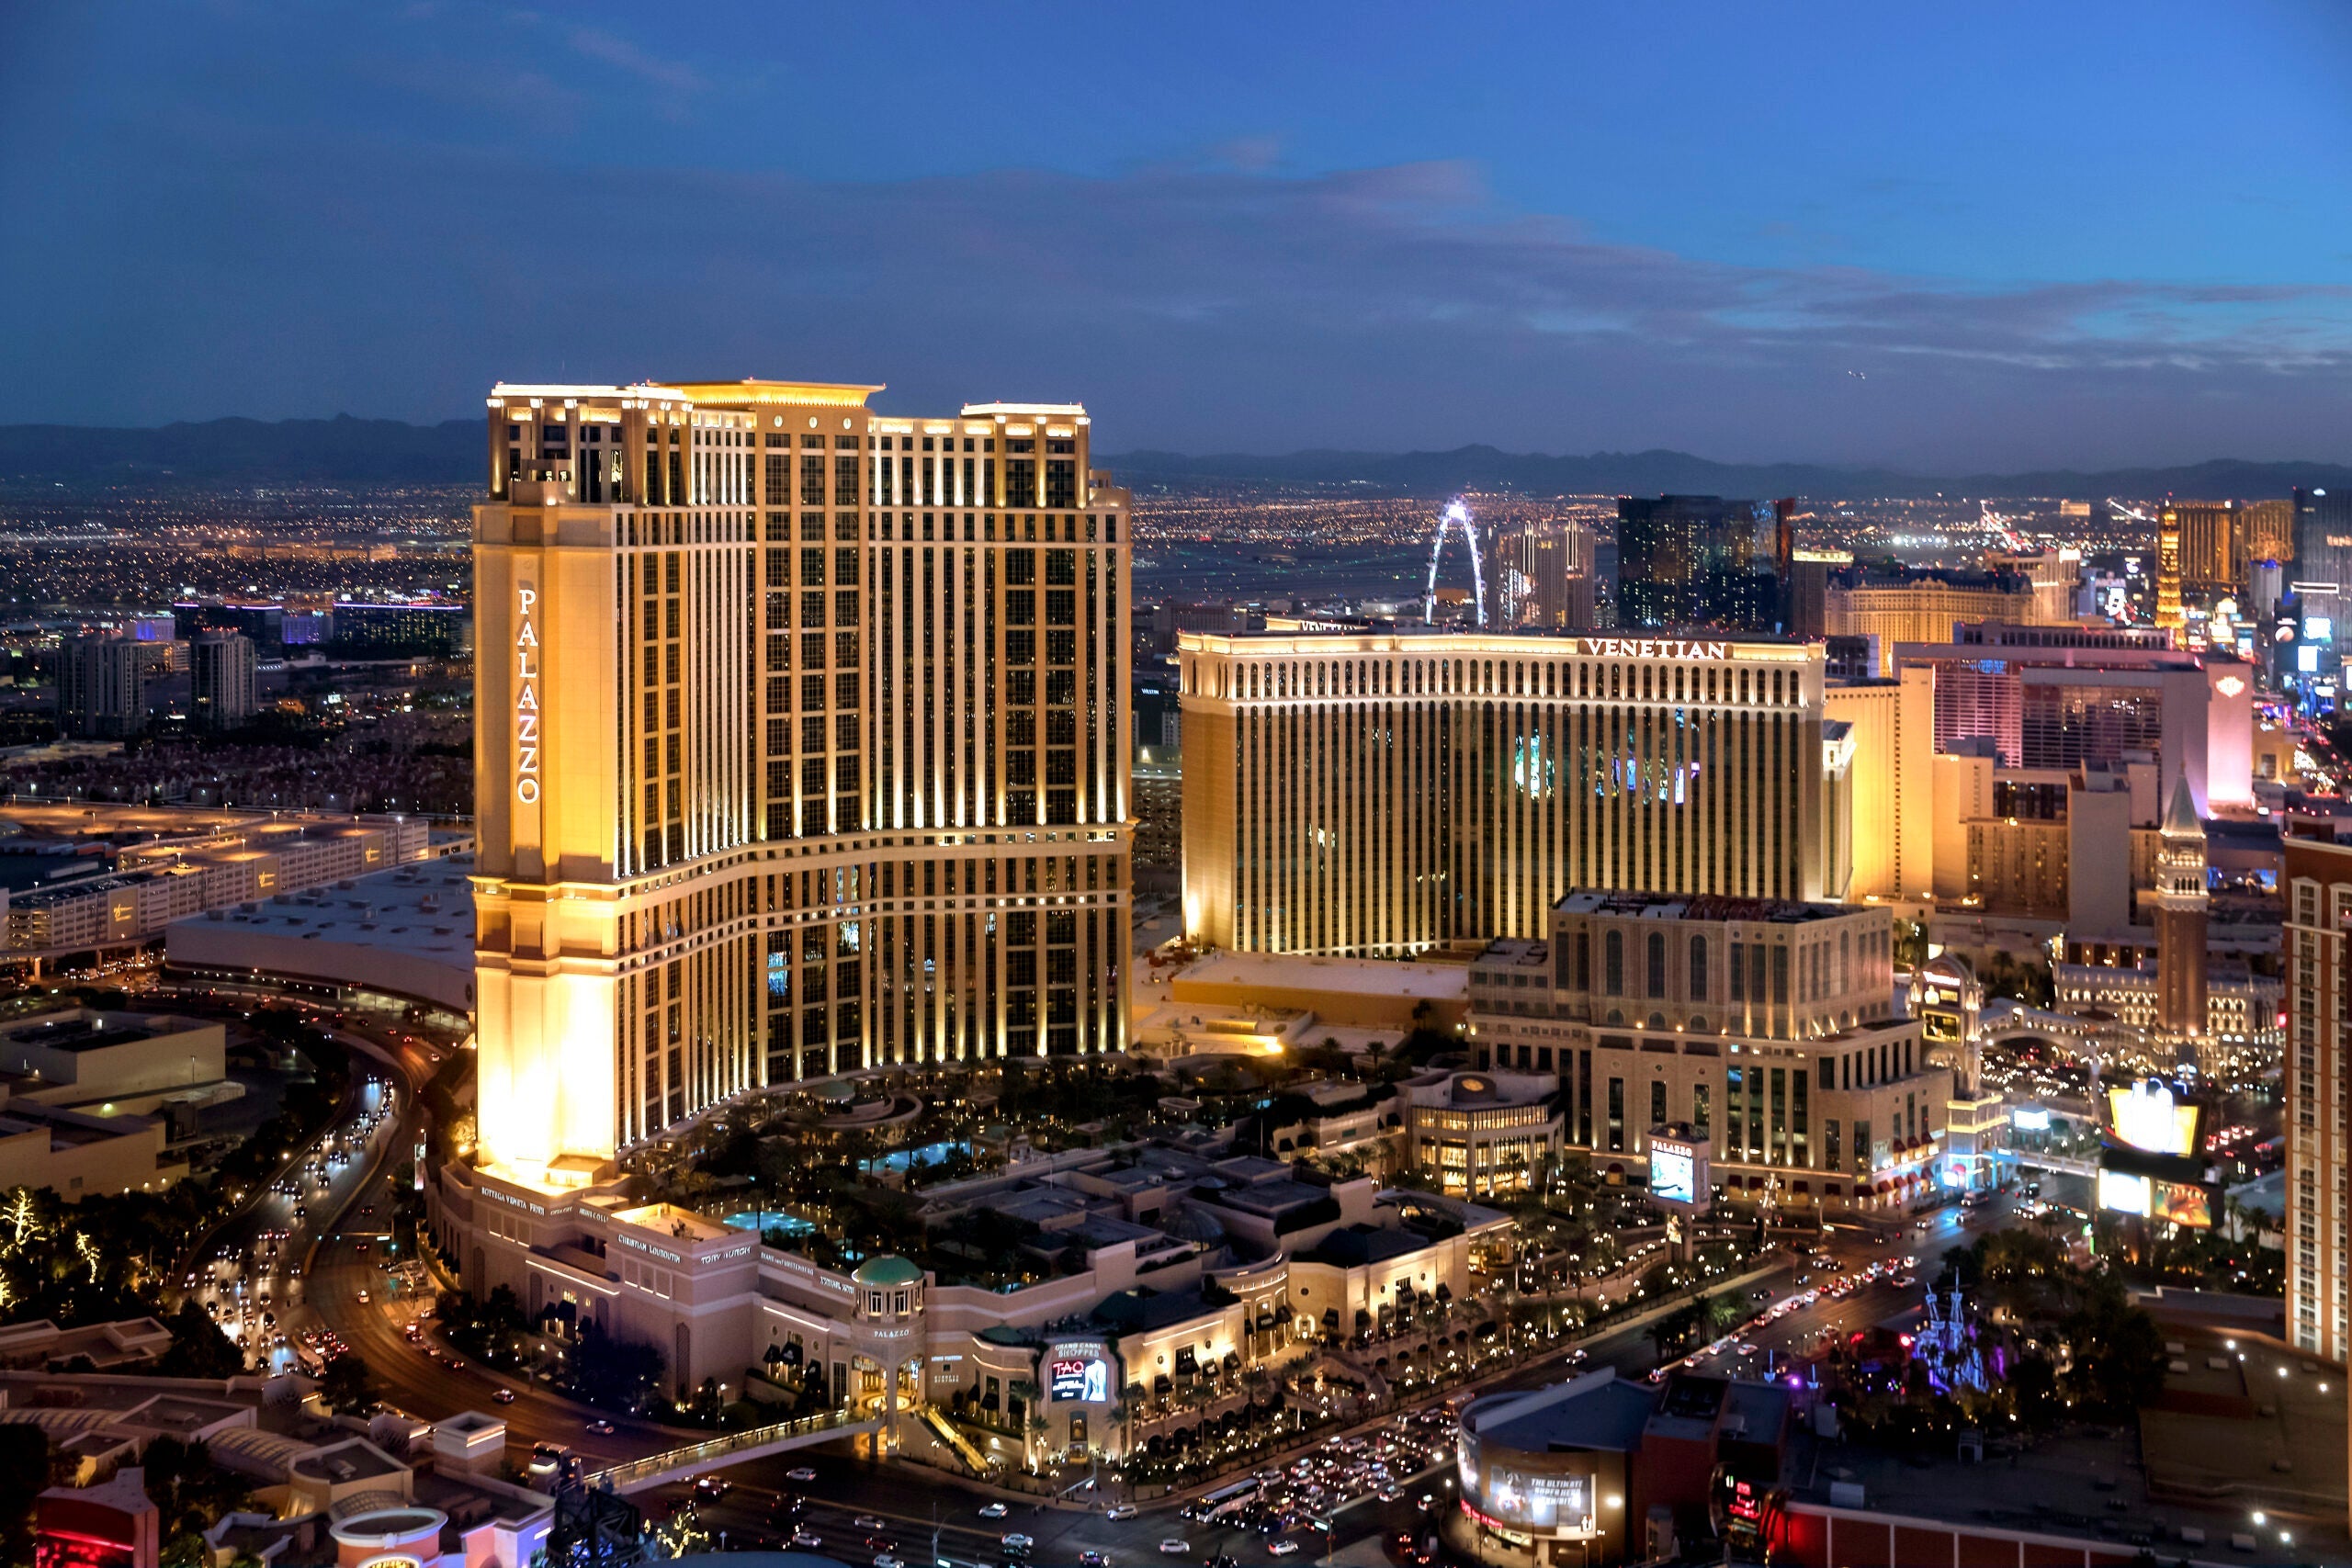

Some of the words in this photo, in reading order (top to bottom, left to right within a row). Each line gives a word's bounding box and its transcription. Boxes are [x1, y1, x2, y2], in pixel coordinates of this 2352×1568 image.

[1584, 637, 1726, 660] VENETIAN
[517, 589, 539, 804] PALAZZO
[1652, 1140, 1692, 1157] PALAZZO
[481, 1186, 504, 1201] BOTTEGA
[617, 1234, 647, 1252] CHRISTIAN
[649, 1244, 681, 1263] LOUBOUTIN
[701, 1253, 721, 1265] TORY
[723, 1246, 752, 1259] BURCH
[874, 1329, 910, 1338] PALAZZO
[1055, 1343, 1079, 1351] GRAND
[1079, 1342, 1101, 1350] CANAL
[1052, 1360, 1084, 1376] TAO
[1532, 1478, 1545, 1486] THE
[1546, 1479, 1582, 1488] ULTIMATE
[1534, 1487, 1559, 1496] SUPER
